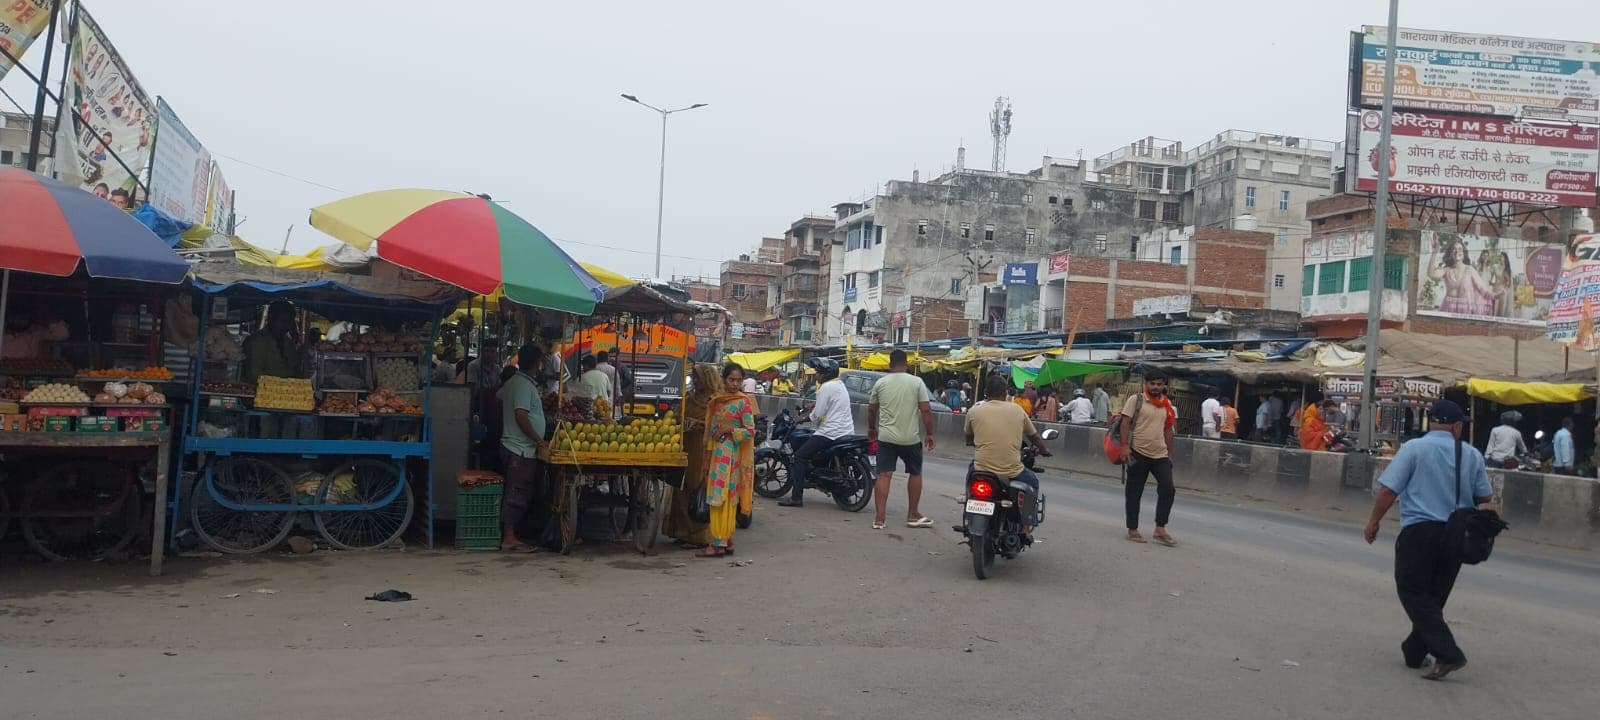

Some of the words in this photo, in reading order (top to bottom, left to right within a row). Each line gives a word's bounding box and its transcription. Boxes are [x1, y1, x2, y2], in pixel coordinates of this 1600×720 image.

[1400, 31, 1438, 43] नारायण
[1440, 33, 1476, 45] मेडिकल
[1479, 36, 1509, 48] कॉलेज
[1511, 38, 1524, 48] एवं
[1527, 40, 1565, 52] अस्पताल
[1392, 112, 1446, 128] हेरिटेज
[1452, 120, 1457, 129] I
[1462, 121, 1479, 131] M
[1485, 123, 1498, 132] S
[1502, 121, 1569, 138] हॉस्पिटल
[1407, 144, 1434, 158] ओपन
[1438, 146, 1456, 160] हार्ट
[1460, 147, 1488, 161] सर्जरी
[1492, 149, 1502, 163] से
[1505, 150, 1530, 165] लेकर
[1407, 163, 1440, 177] प्राइमरी
[1444, 164, 1506, 182] एंजियोप्लास्टी
[1476, 188, 1558, 203] 740-860-2222
[662, 386, 679, 394] STOP
